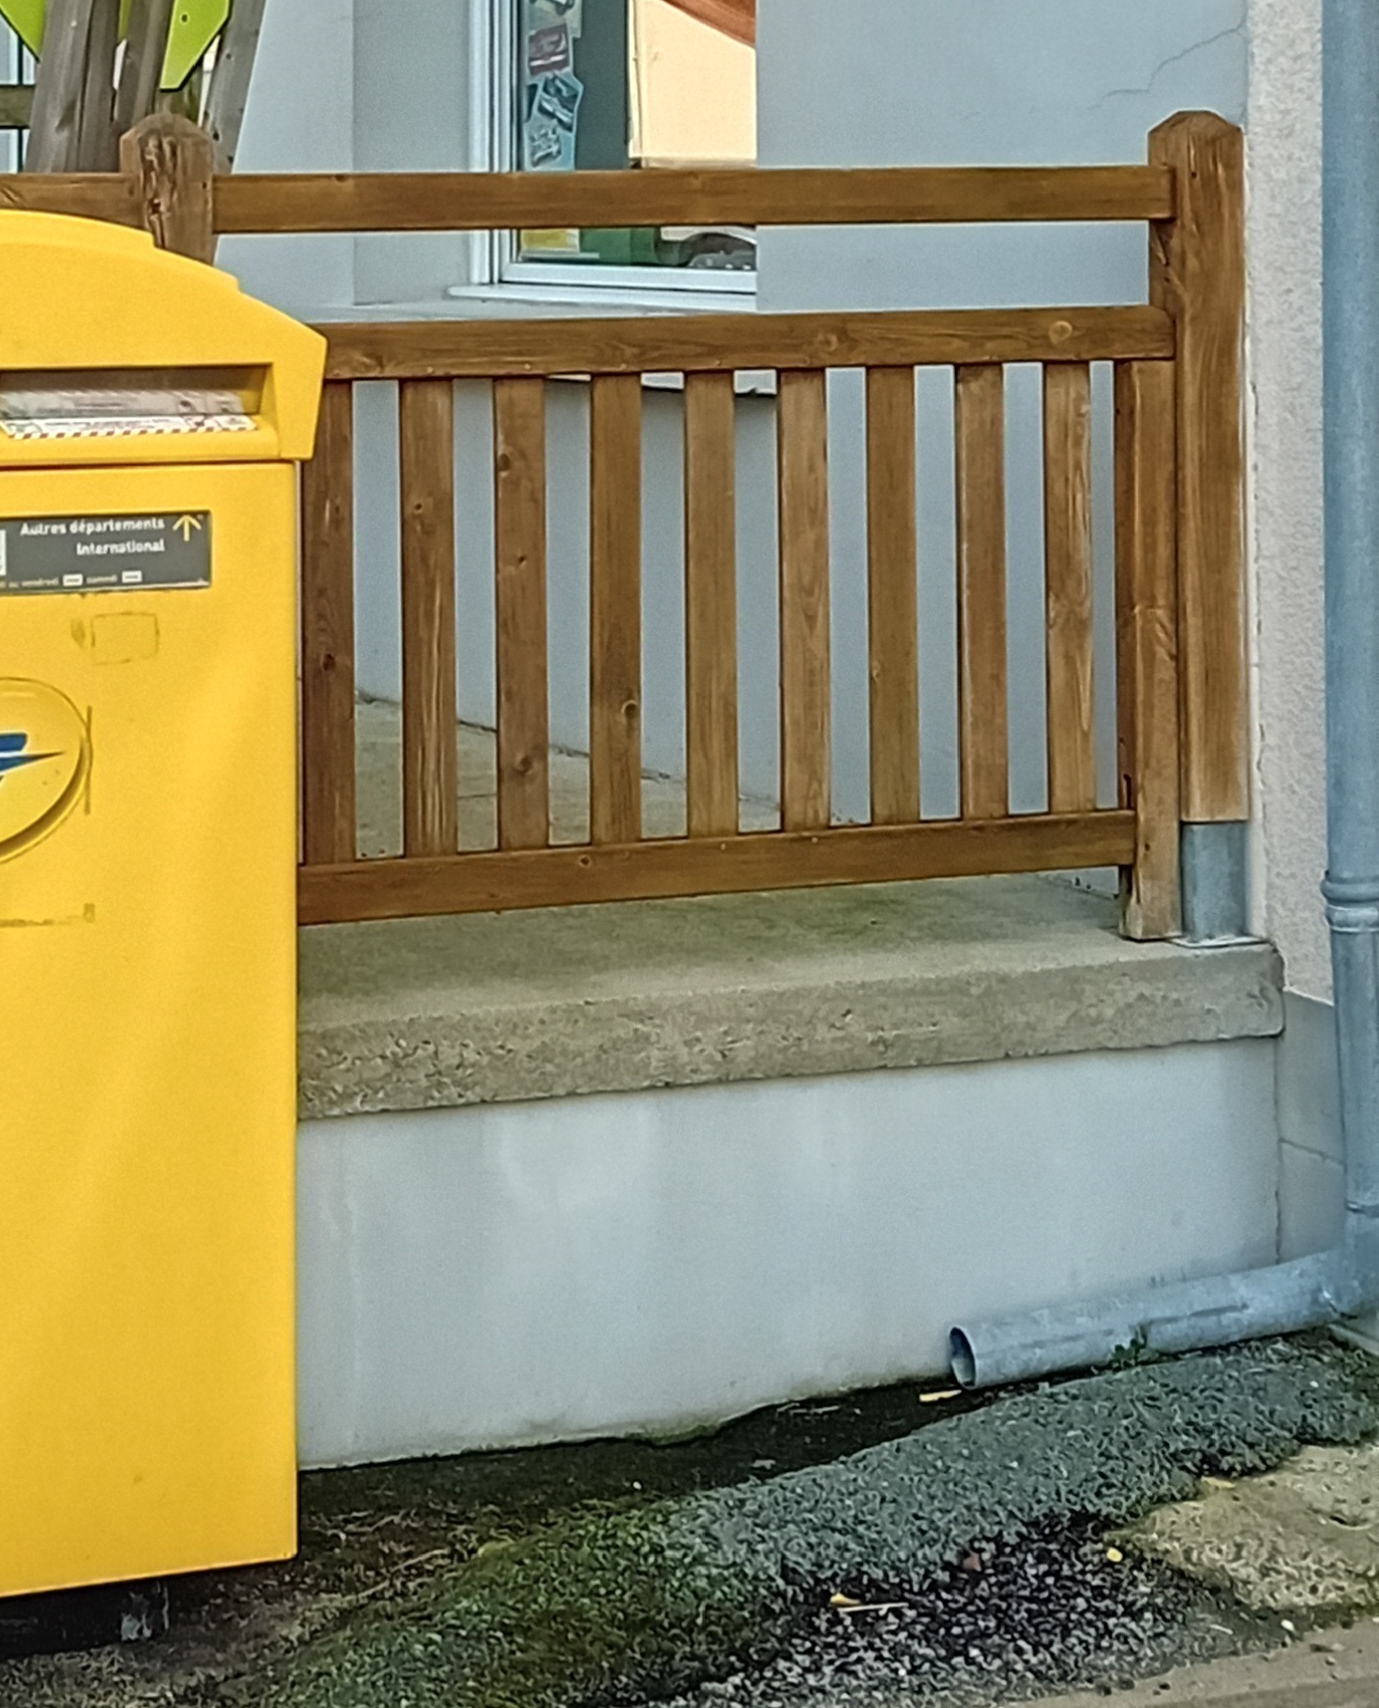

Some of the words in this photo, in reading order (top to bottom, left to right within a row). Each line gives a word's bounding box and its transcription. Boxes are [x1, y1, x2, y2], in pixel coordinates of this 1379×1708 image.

[20, 522, 67, 536] Autres
[69, 517, 165, 535] départements
[76, 538, 165, 556] International
